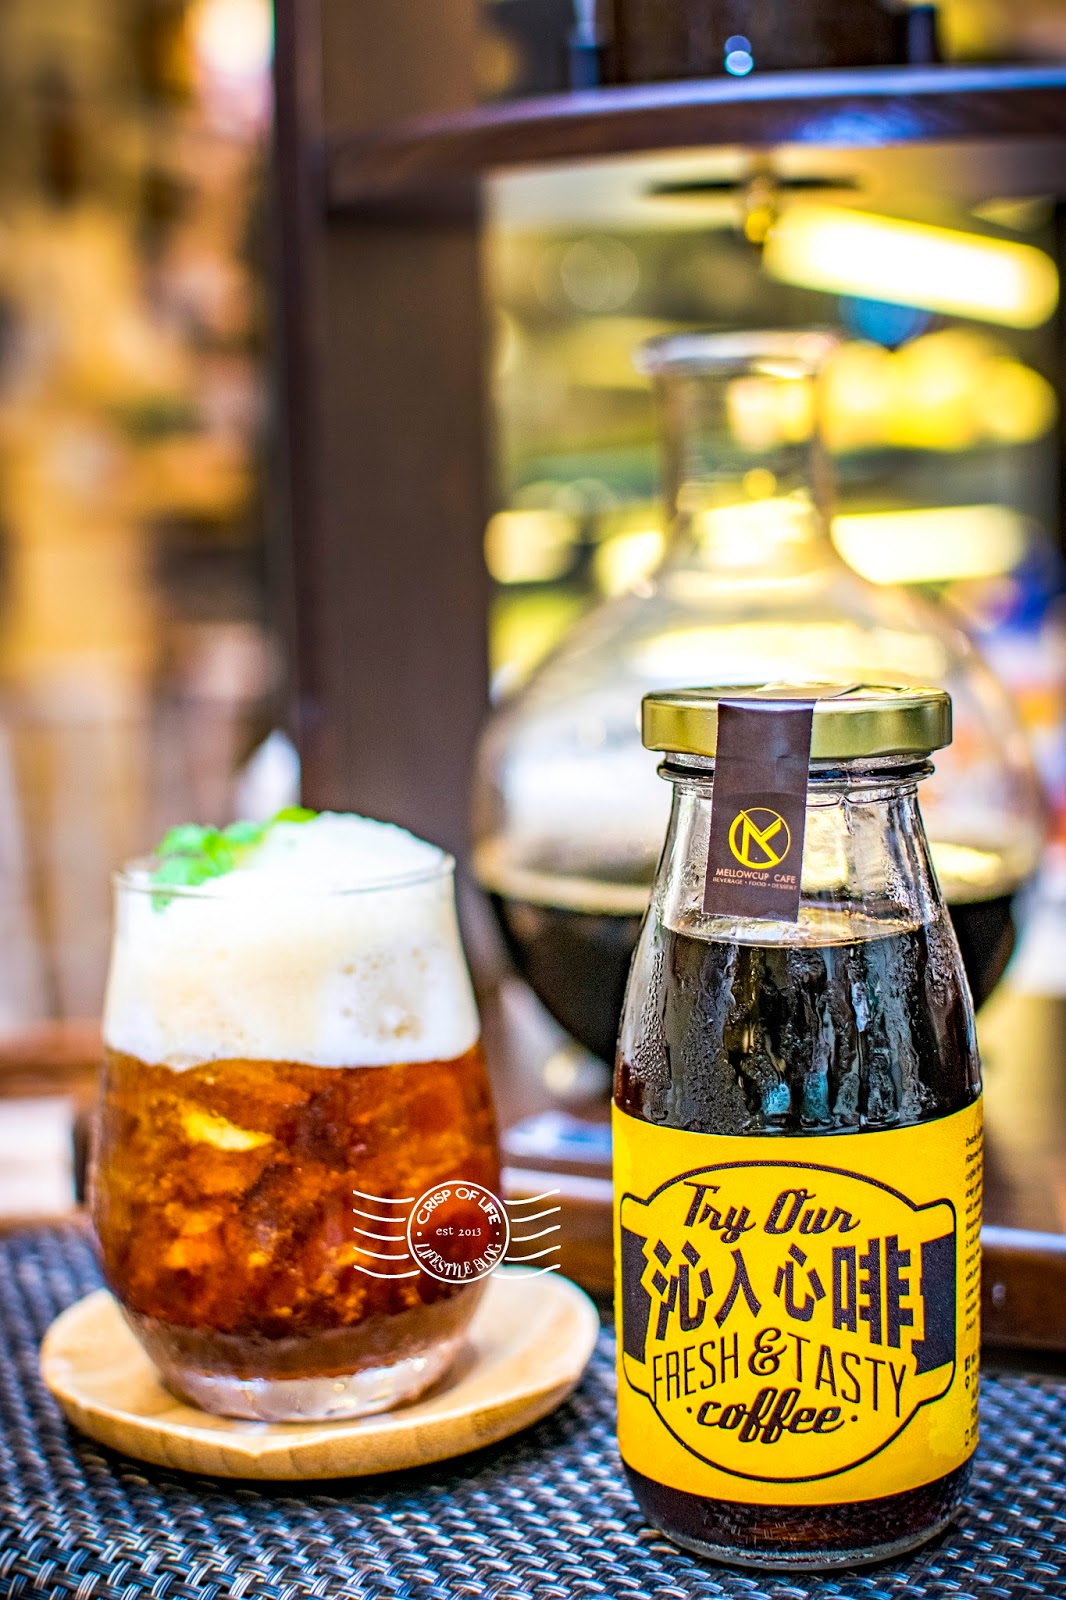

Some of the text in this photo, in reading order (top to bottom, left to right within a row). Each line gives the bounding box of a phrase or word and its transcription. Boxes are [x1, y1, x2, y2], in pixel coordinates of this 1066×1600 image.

[712, 876, 743, 885] BEVERAGE
[715, 868, 797, 884] MELLOWCUP CAFE
[683, 1181, 860, 1243] Try Our
[651, 1234, 914, 1349] 沁人心啡
[652, 1332, 739, 1406] FRESH
[748, 1327, 788, 1376] &
[787, 1332, 907, 1418] TASTY
[696, 1387, 845, 1444] coffee
